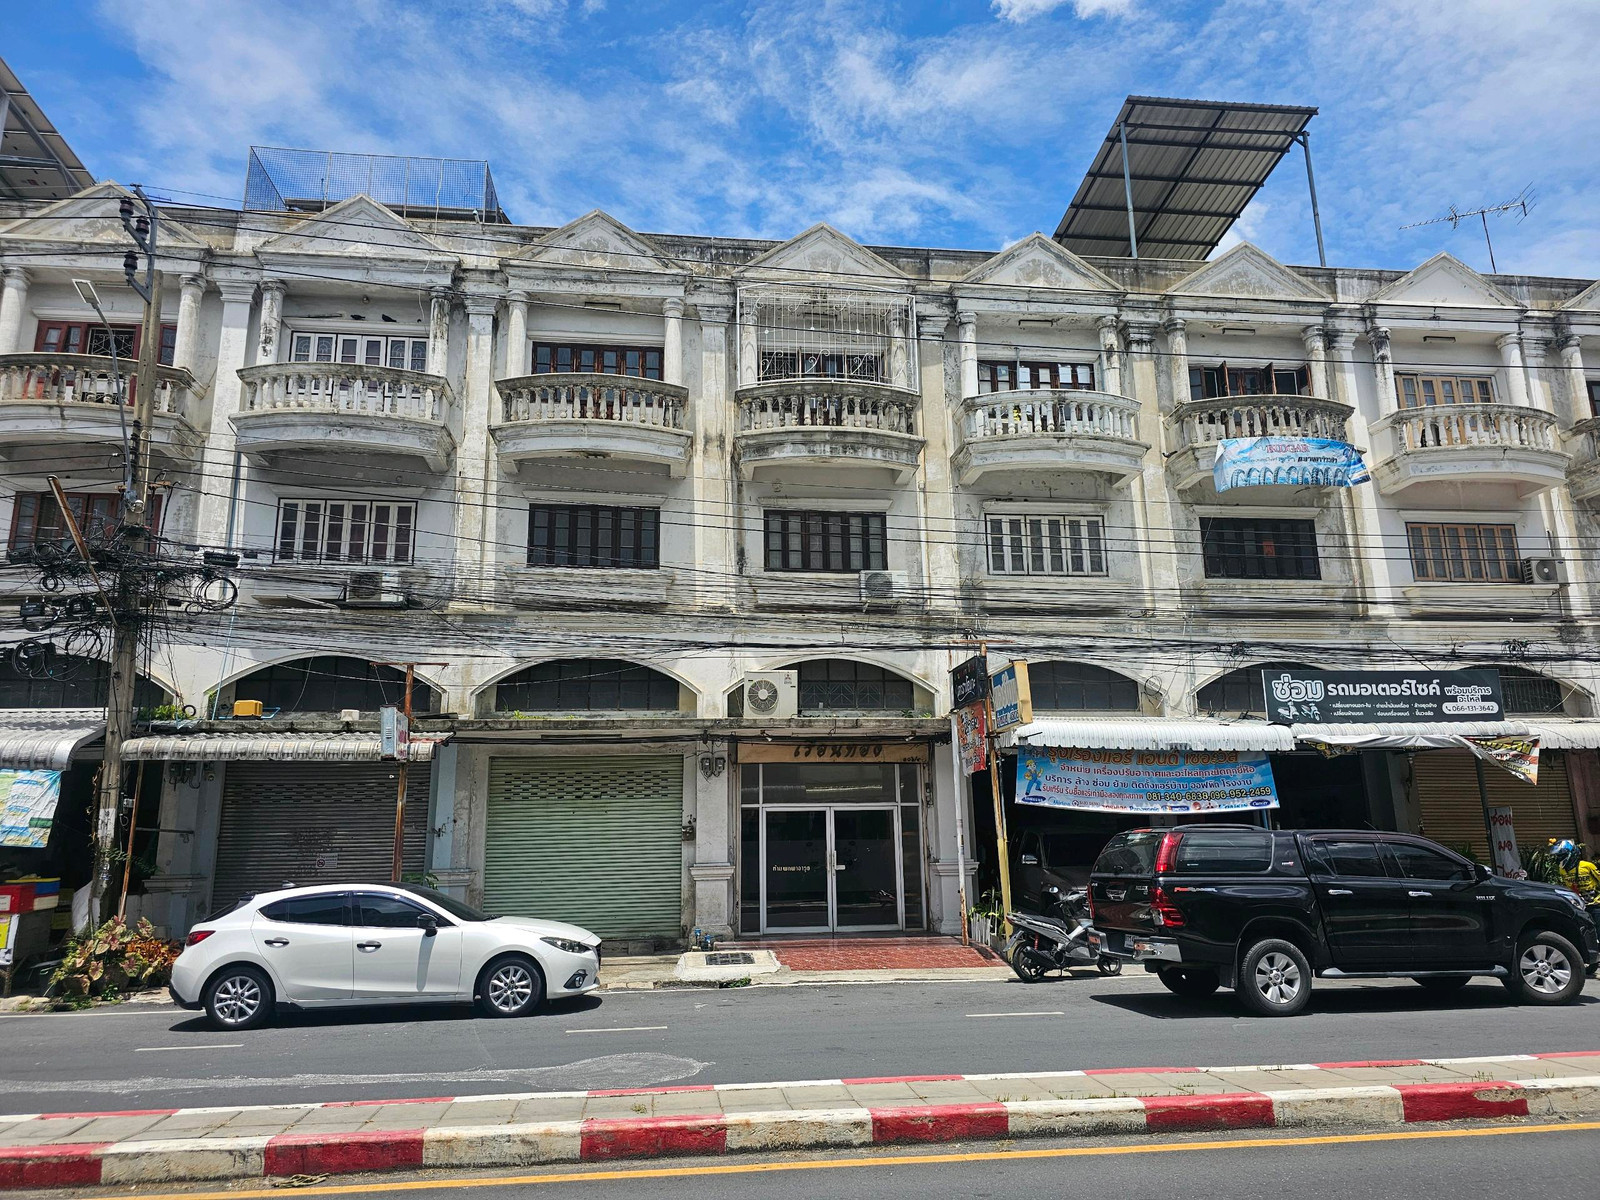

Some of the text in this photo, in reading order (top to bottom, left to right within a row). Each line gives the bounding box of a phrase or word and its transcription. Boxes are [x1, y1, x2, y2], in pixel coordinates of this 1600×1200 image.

[1272, 674, 1441, 701] ซ่อม รถมอเตอร์ไซค์
[1444, 685, 1492, 695] พร้อมบริการ
[1457, 694, 1482, 703] อะไหล่
[1452, 703, 1494, 711] 066-131-3642
[1060, 763, 1091, 774] จำหน่าย
[1045, 774, 1072, 784] บริการ
[1075, 776, 1090, 786] ล้าง
[1092, 777, 1110, 788] ซ่อม
[1112, 779, 1129, 789] ย้าย
[1221, 778, 1252, 788] โรงงาน
[1491, 809, 1512, 826] ซ่อม
[1498, 840, 1513, 850] มอ
